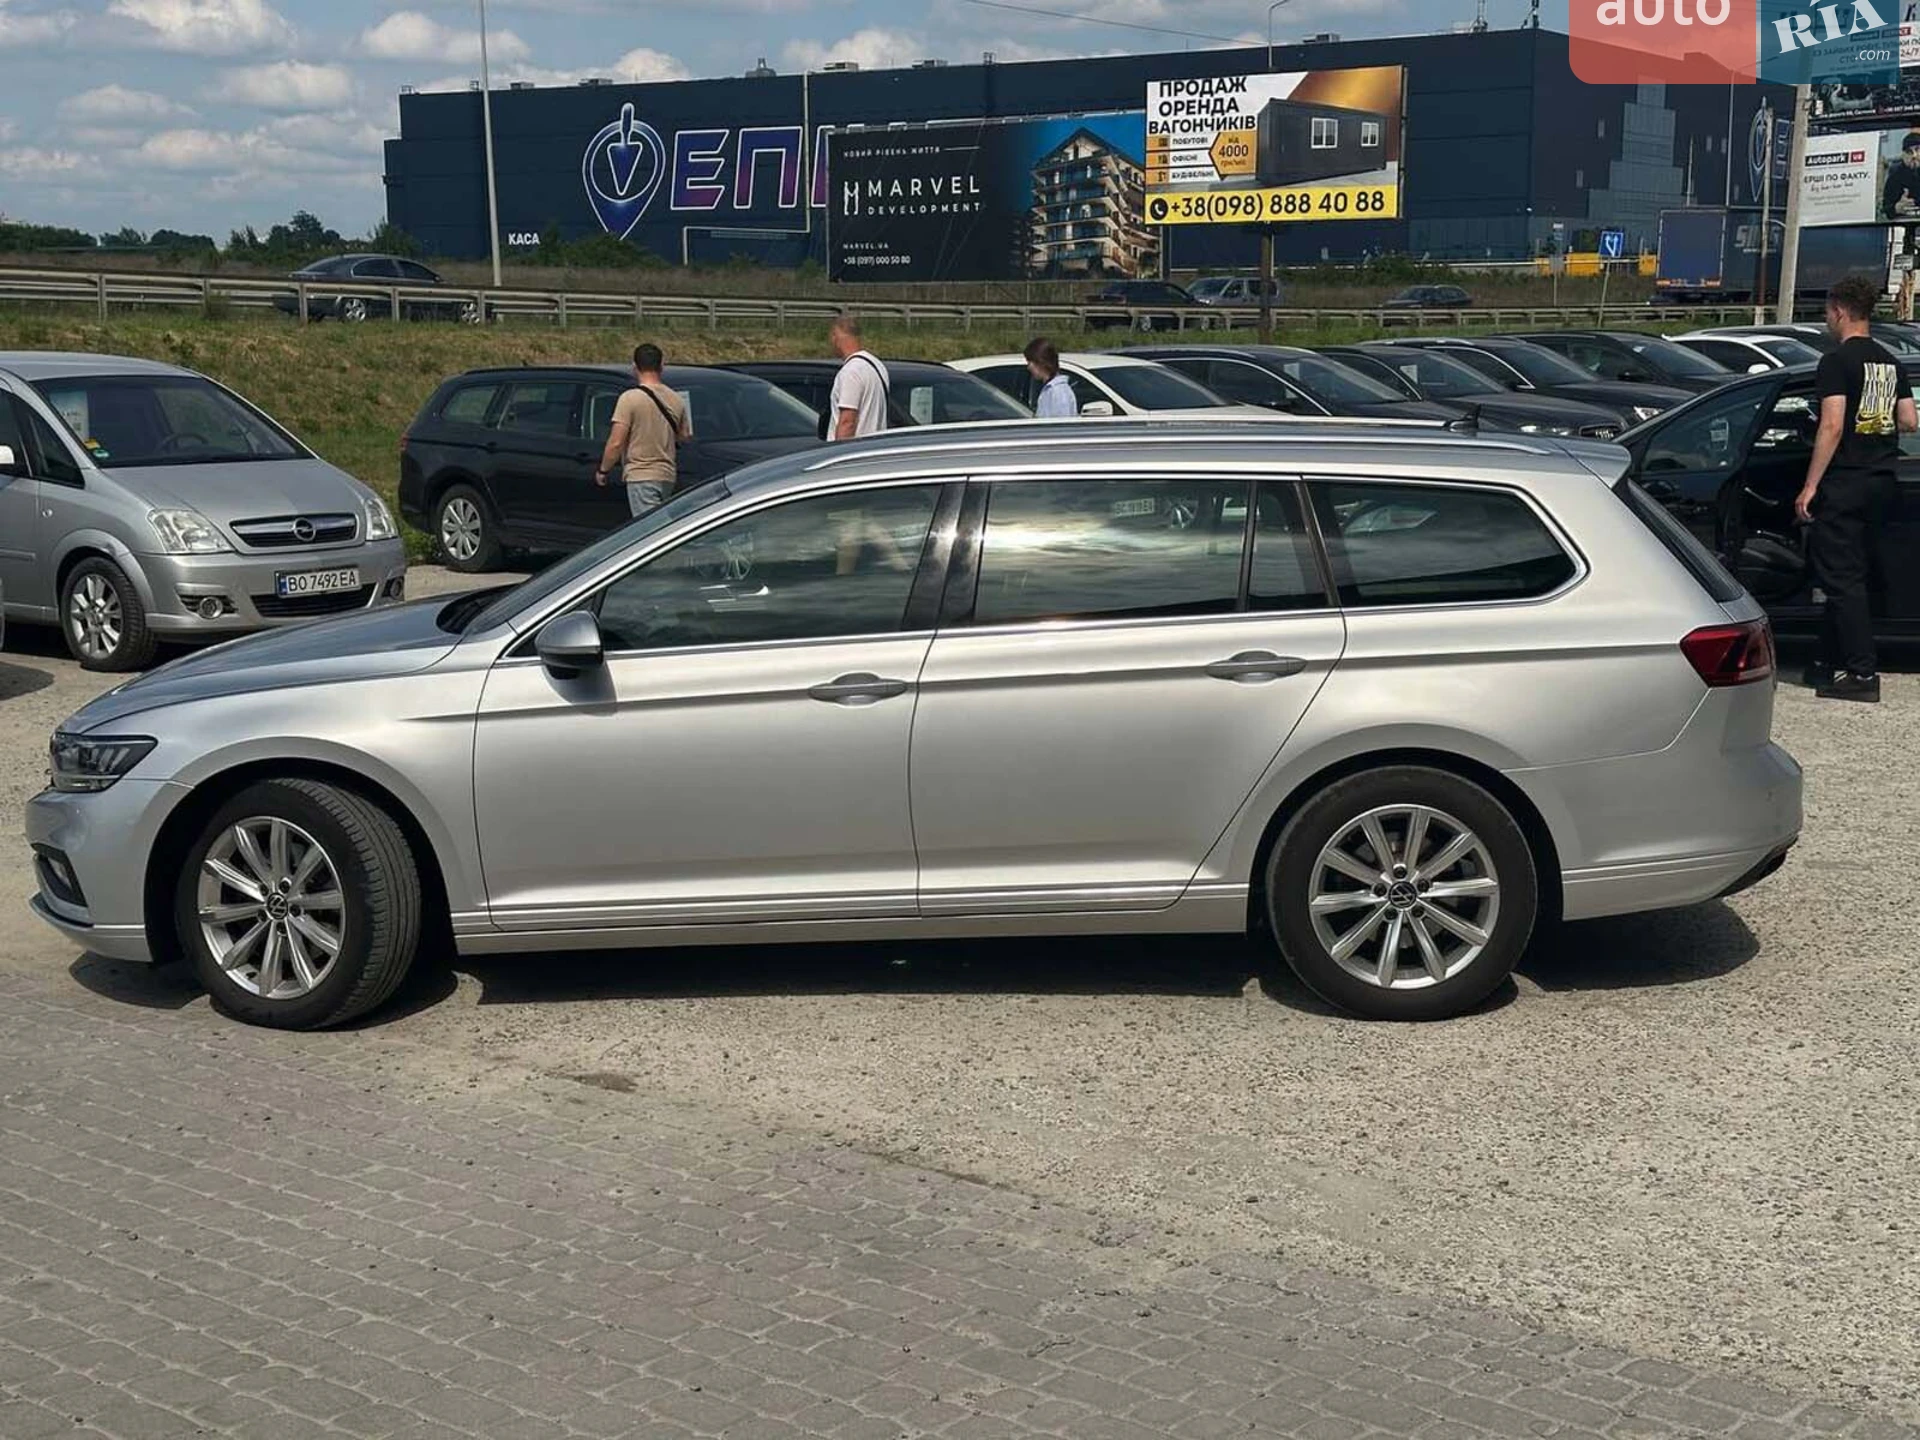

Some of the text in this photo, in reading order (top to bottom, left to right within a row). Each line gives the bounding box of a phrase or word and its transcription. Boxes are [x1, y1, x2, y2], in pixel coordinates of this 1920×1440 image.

[1160, 77, 1247, 97] ПРОДАЖ
[1159, 97, 1239, 117] ОРЕНДА
[1149, 115, 1256, 134] ВАГОНЧИКІВ
[1218, 144, 1249, 157] 4000
[868, 175, 980, 198] MARVEL
[868, 202, 980, 215] DEVELOPMENT
[1171, 190, 1385, 221] +38(098) 888 40 88
[508, 232, 540, 246] КАСА
[875, 256, 890, 265] 000
[288, 571, 356, 591] BO 7492 EA
